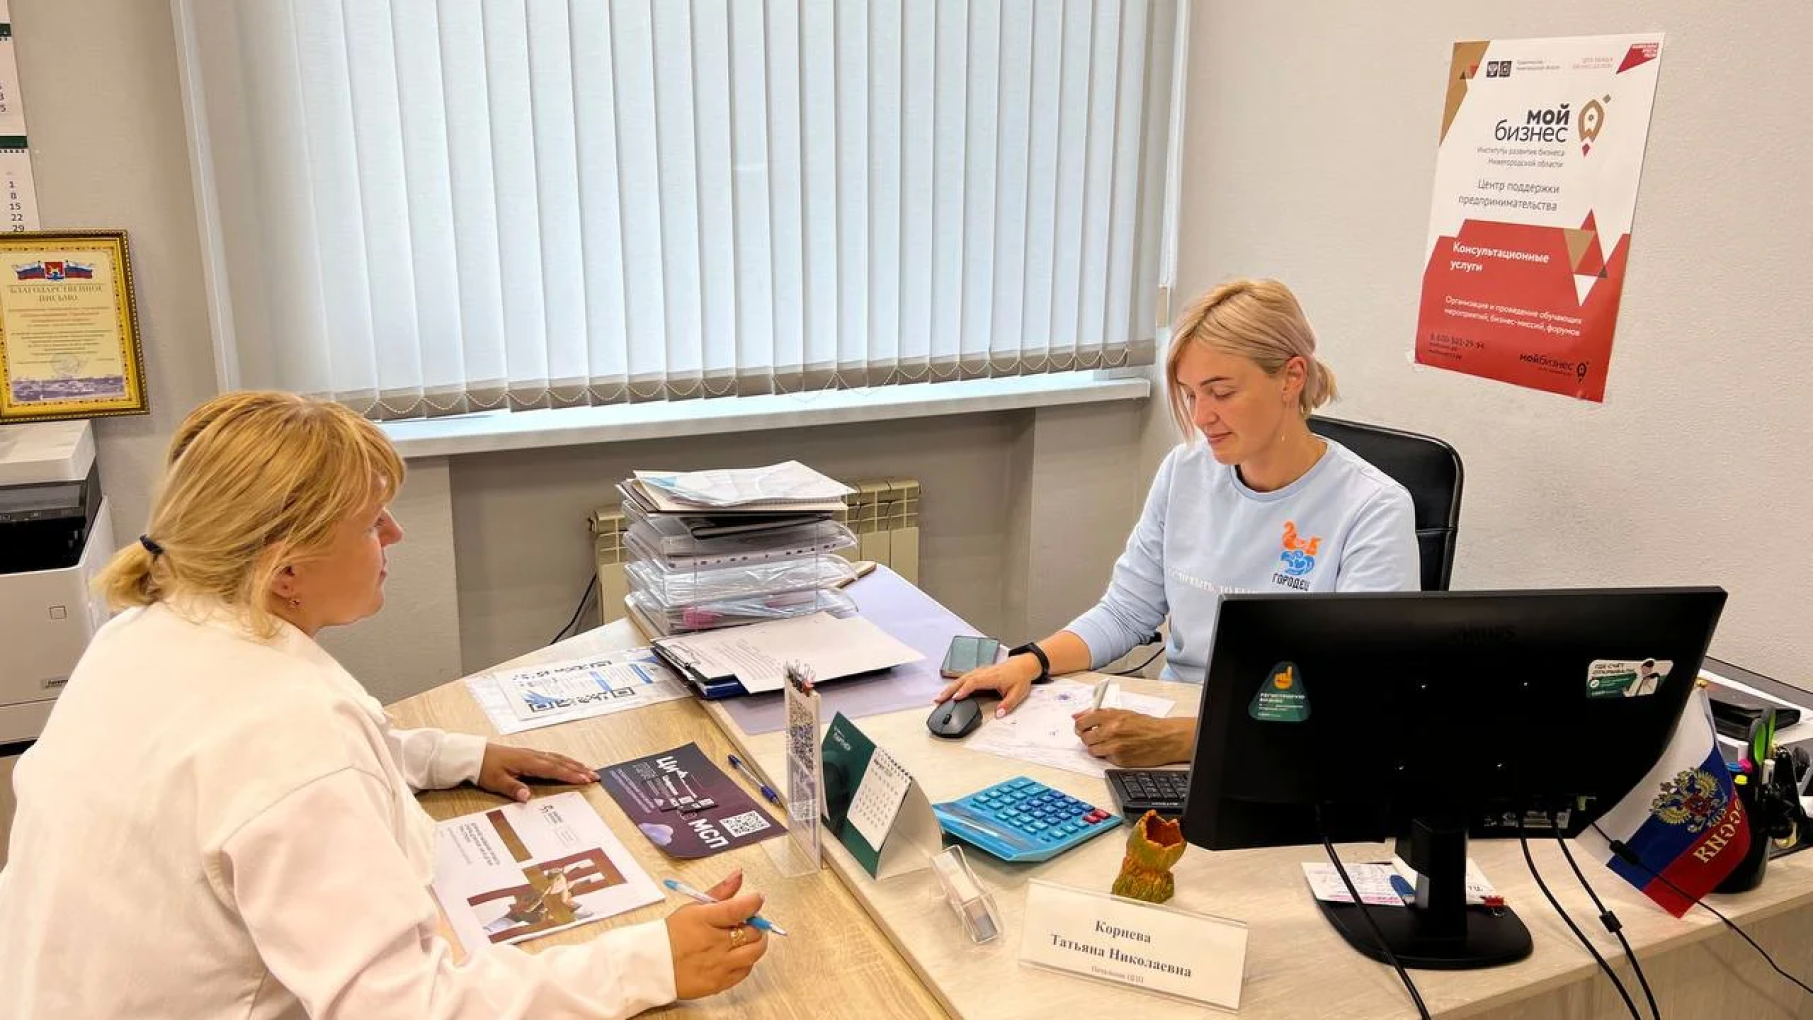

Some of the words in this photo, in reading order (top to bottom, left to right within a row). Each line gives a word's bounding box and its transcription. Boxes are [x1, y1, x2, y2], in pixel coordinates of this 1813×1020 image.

[1527, 102, 1570, 125] мой
[1494, 119, 1569, 143] бизнес
[1538, 147, 1565, 157] бизнеса
[1537, 159, 1564, 168] области
[1478, 179, 1505, 192] Центр
[1506, 181, 1560, 195] поддержки
[10, 203, 22, 211] 15
[1458, 195, 1558, 212] предпринимательства
[11, 213, 23, 222] 22
[12, 224, 25, 232] 29
[1453, 241, 1550, 263] Консультационные
[1450, 260, 1483, 273] услуги
[1546, 325, 1580, 337] форумов
[1271, 572, 1310, 592] ГОРОДЕЦ
[688, 818, 730, 849] МСП
[1095, 920, 1151, 943] Корнева
[1051, 933, 1104, 957] Татьяна
[1108, 948, 1192, 978] Николаевна
